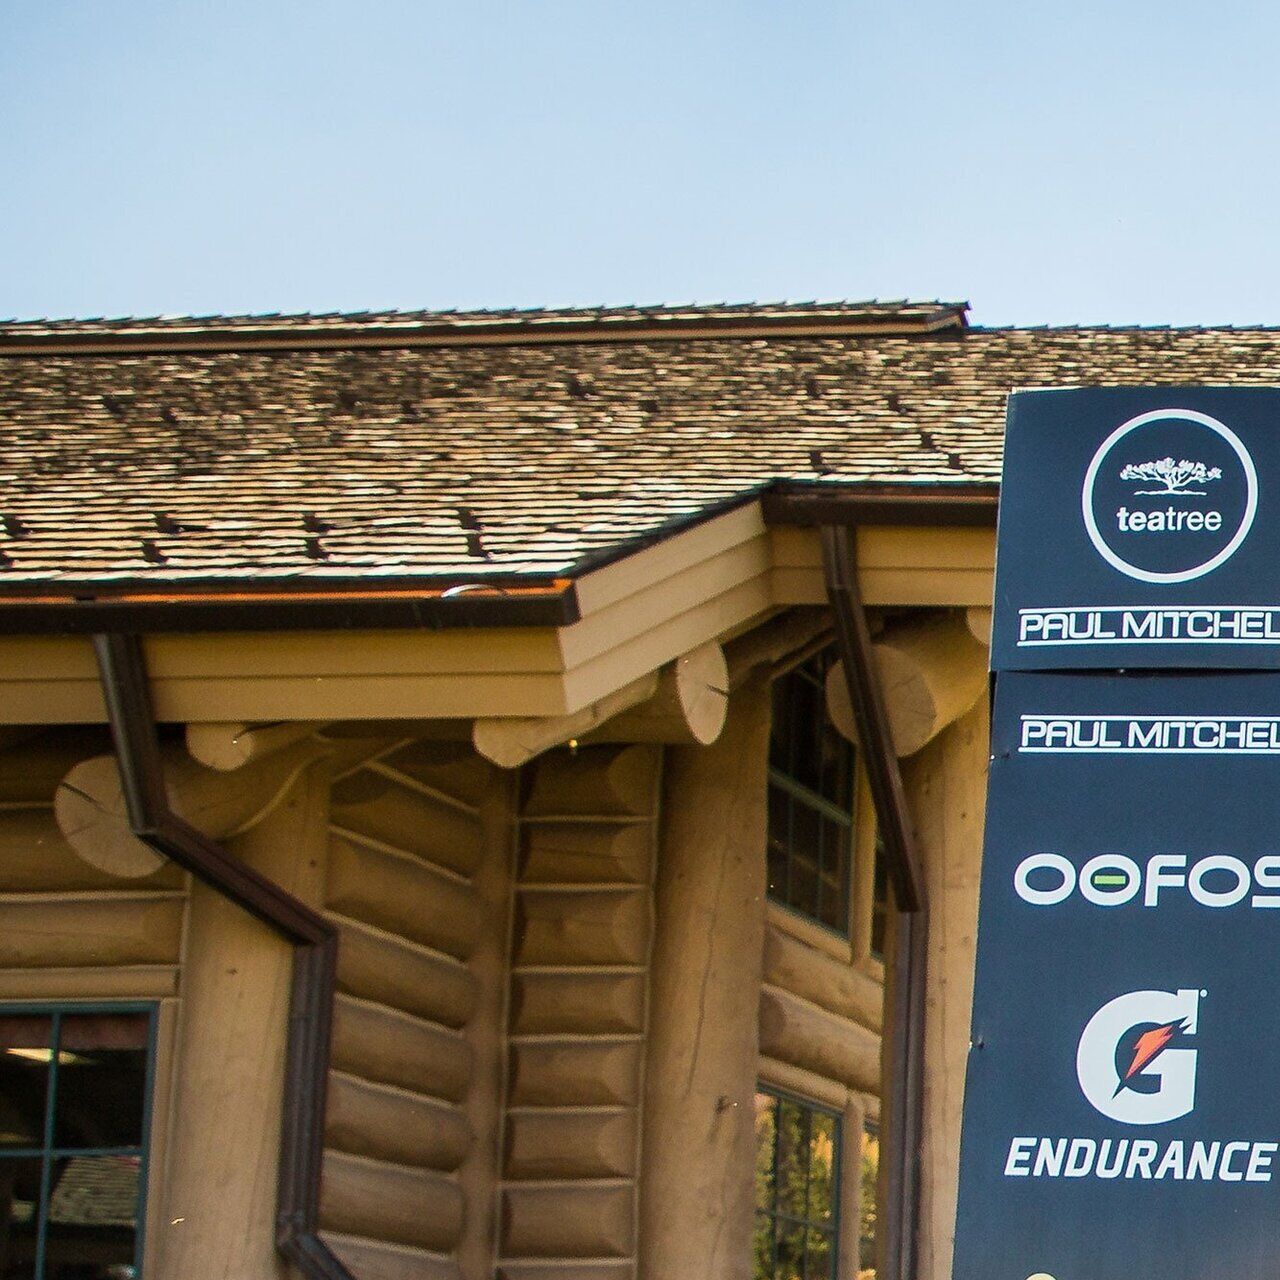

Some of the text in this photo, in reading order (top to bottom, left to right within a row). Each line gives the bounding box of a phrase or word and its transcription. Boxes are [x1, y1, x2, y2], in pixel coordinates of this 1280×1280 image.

[1115, 505, 1222, 534] teatree
[1019, 612, 1115, 640] PAUL
[1021, 719, 1120, 748] PAUL
[1003, 1136, 1279, 1182] ENDURANCE
